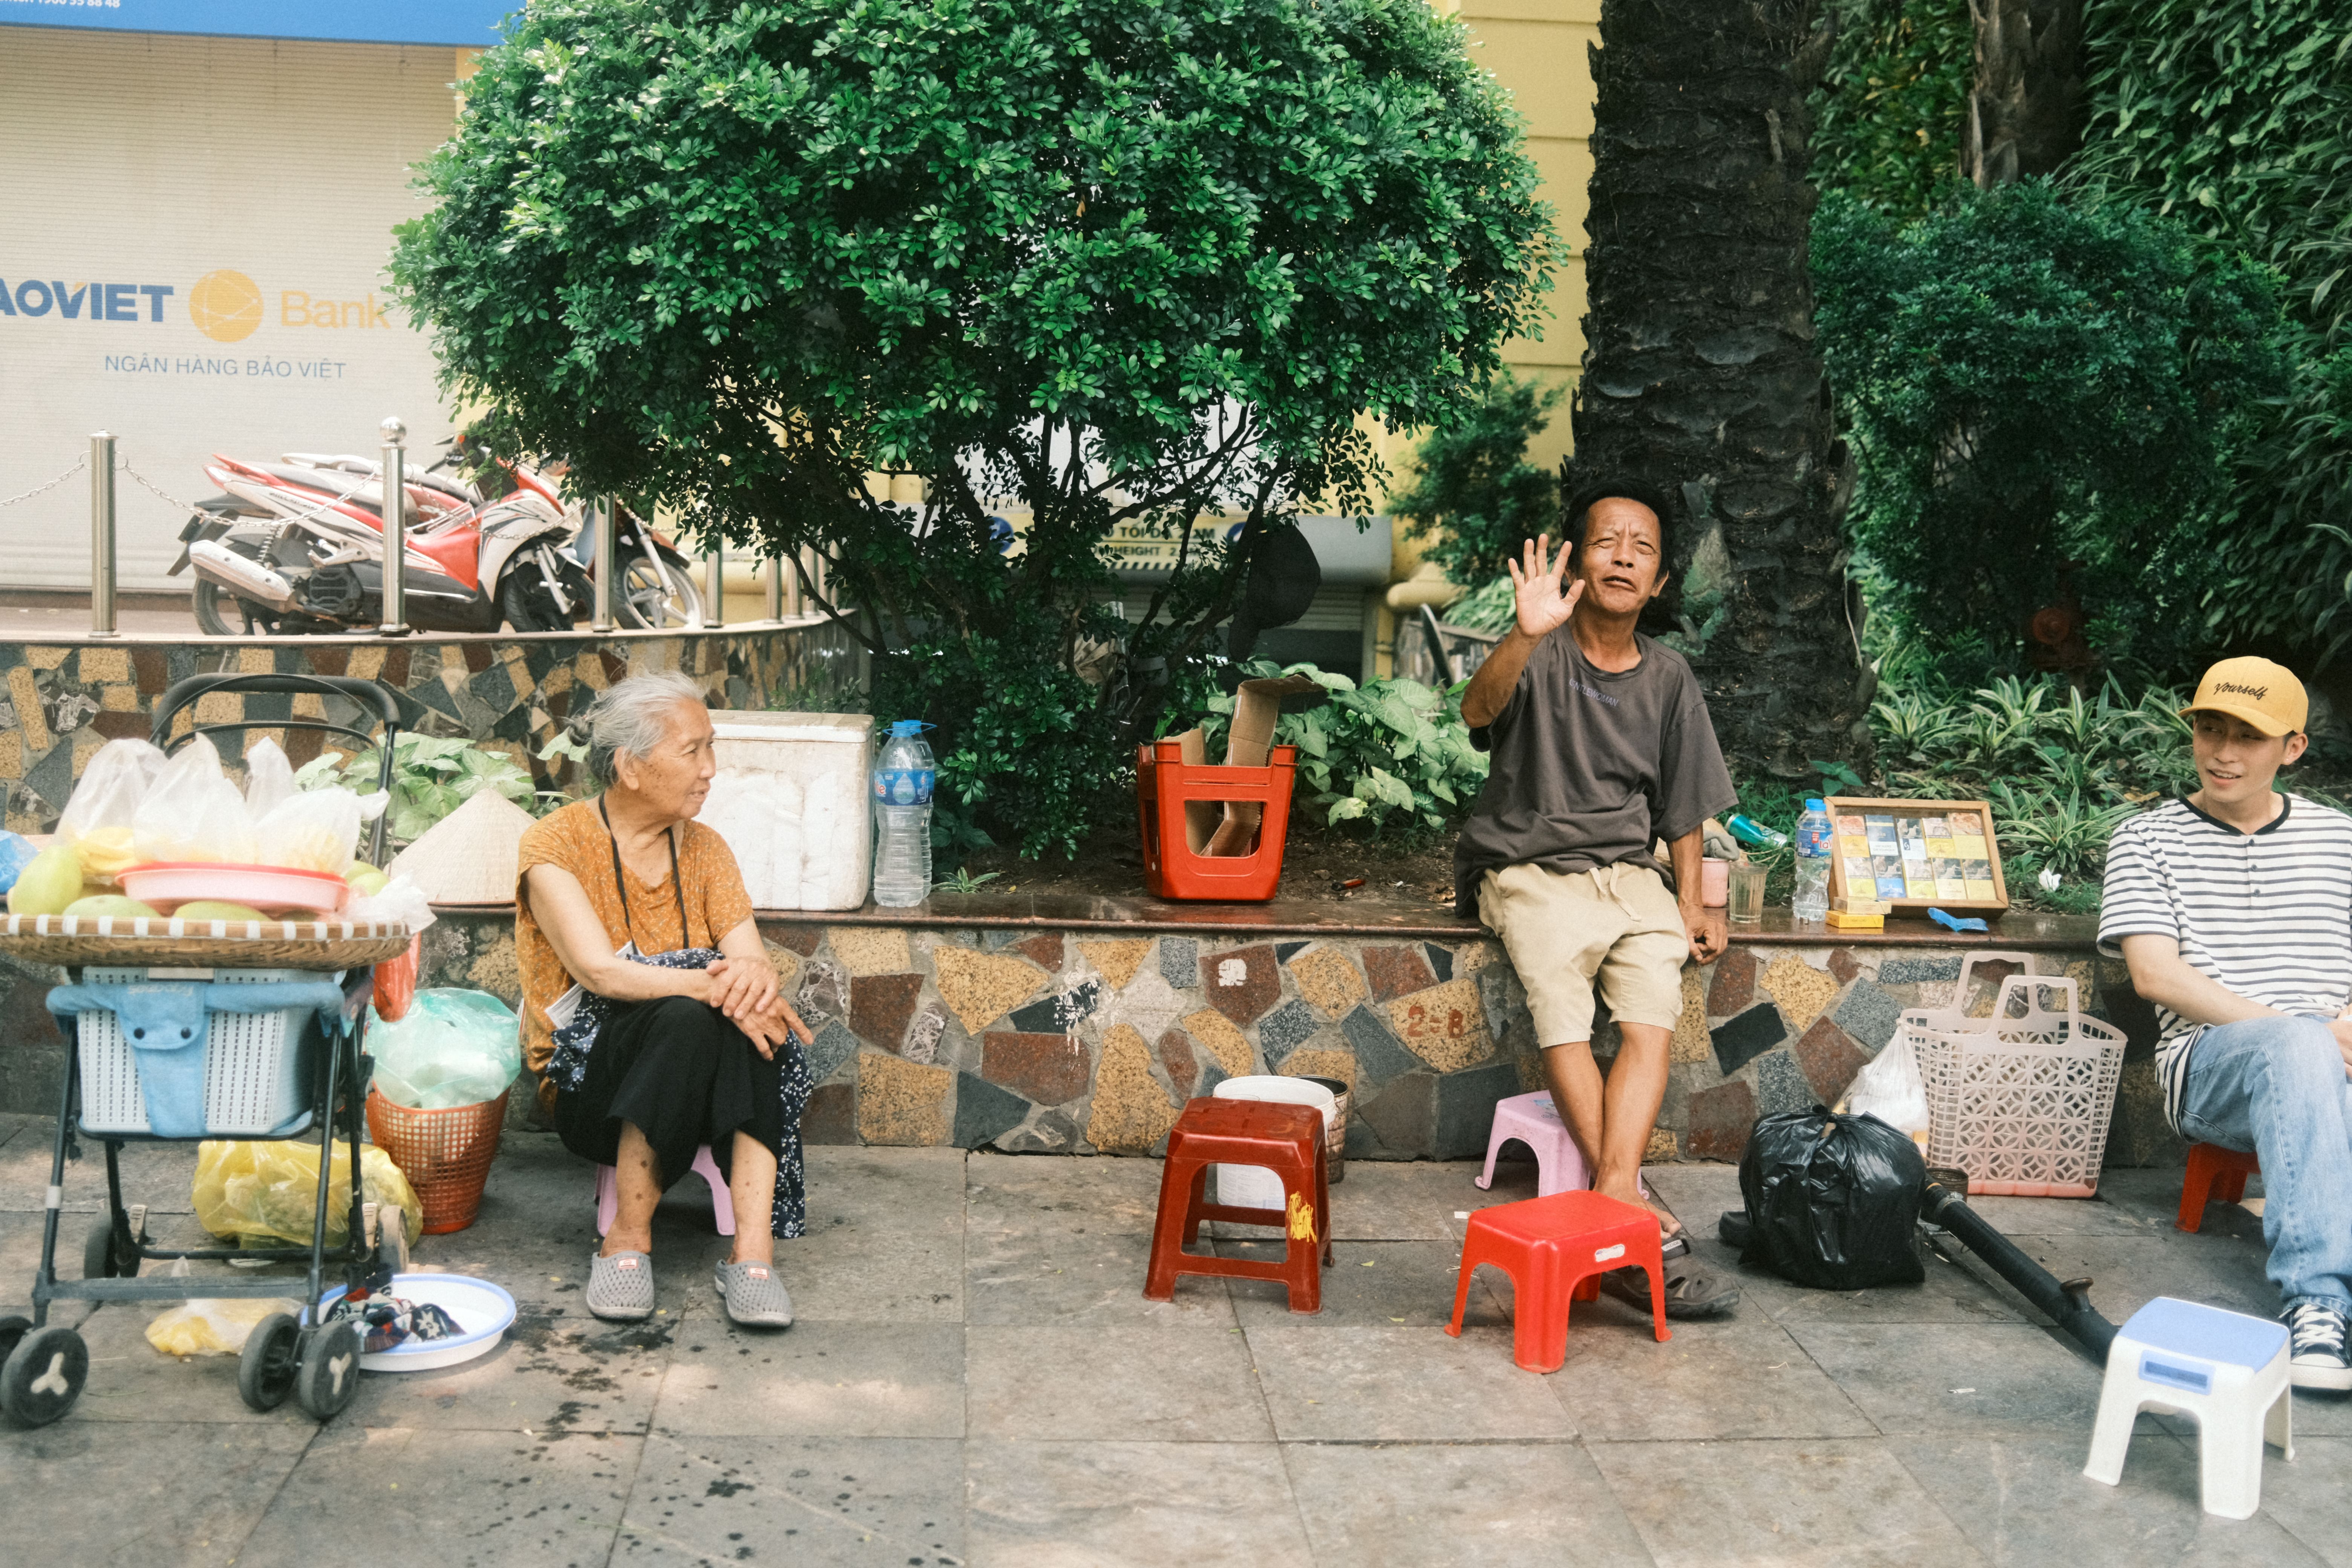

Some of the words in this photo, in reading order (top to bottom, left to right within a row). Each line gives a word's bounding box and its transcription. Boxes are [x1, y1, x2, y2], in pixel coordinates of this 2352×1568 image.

[281, 289, 391, 329] Bank
[105, 353, 168, 373] NGÂN
[176, 354, 238, 375] HÀNG
[247, 355, 292, 377] BẢO
[299, 358, 347, 381] VIỆT
